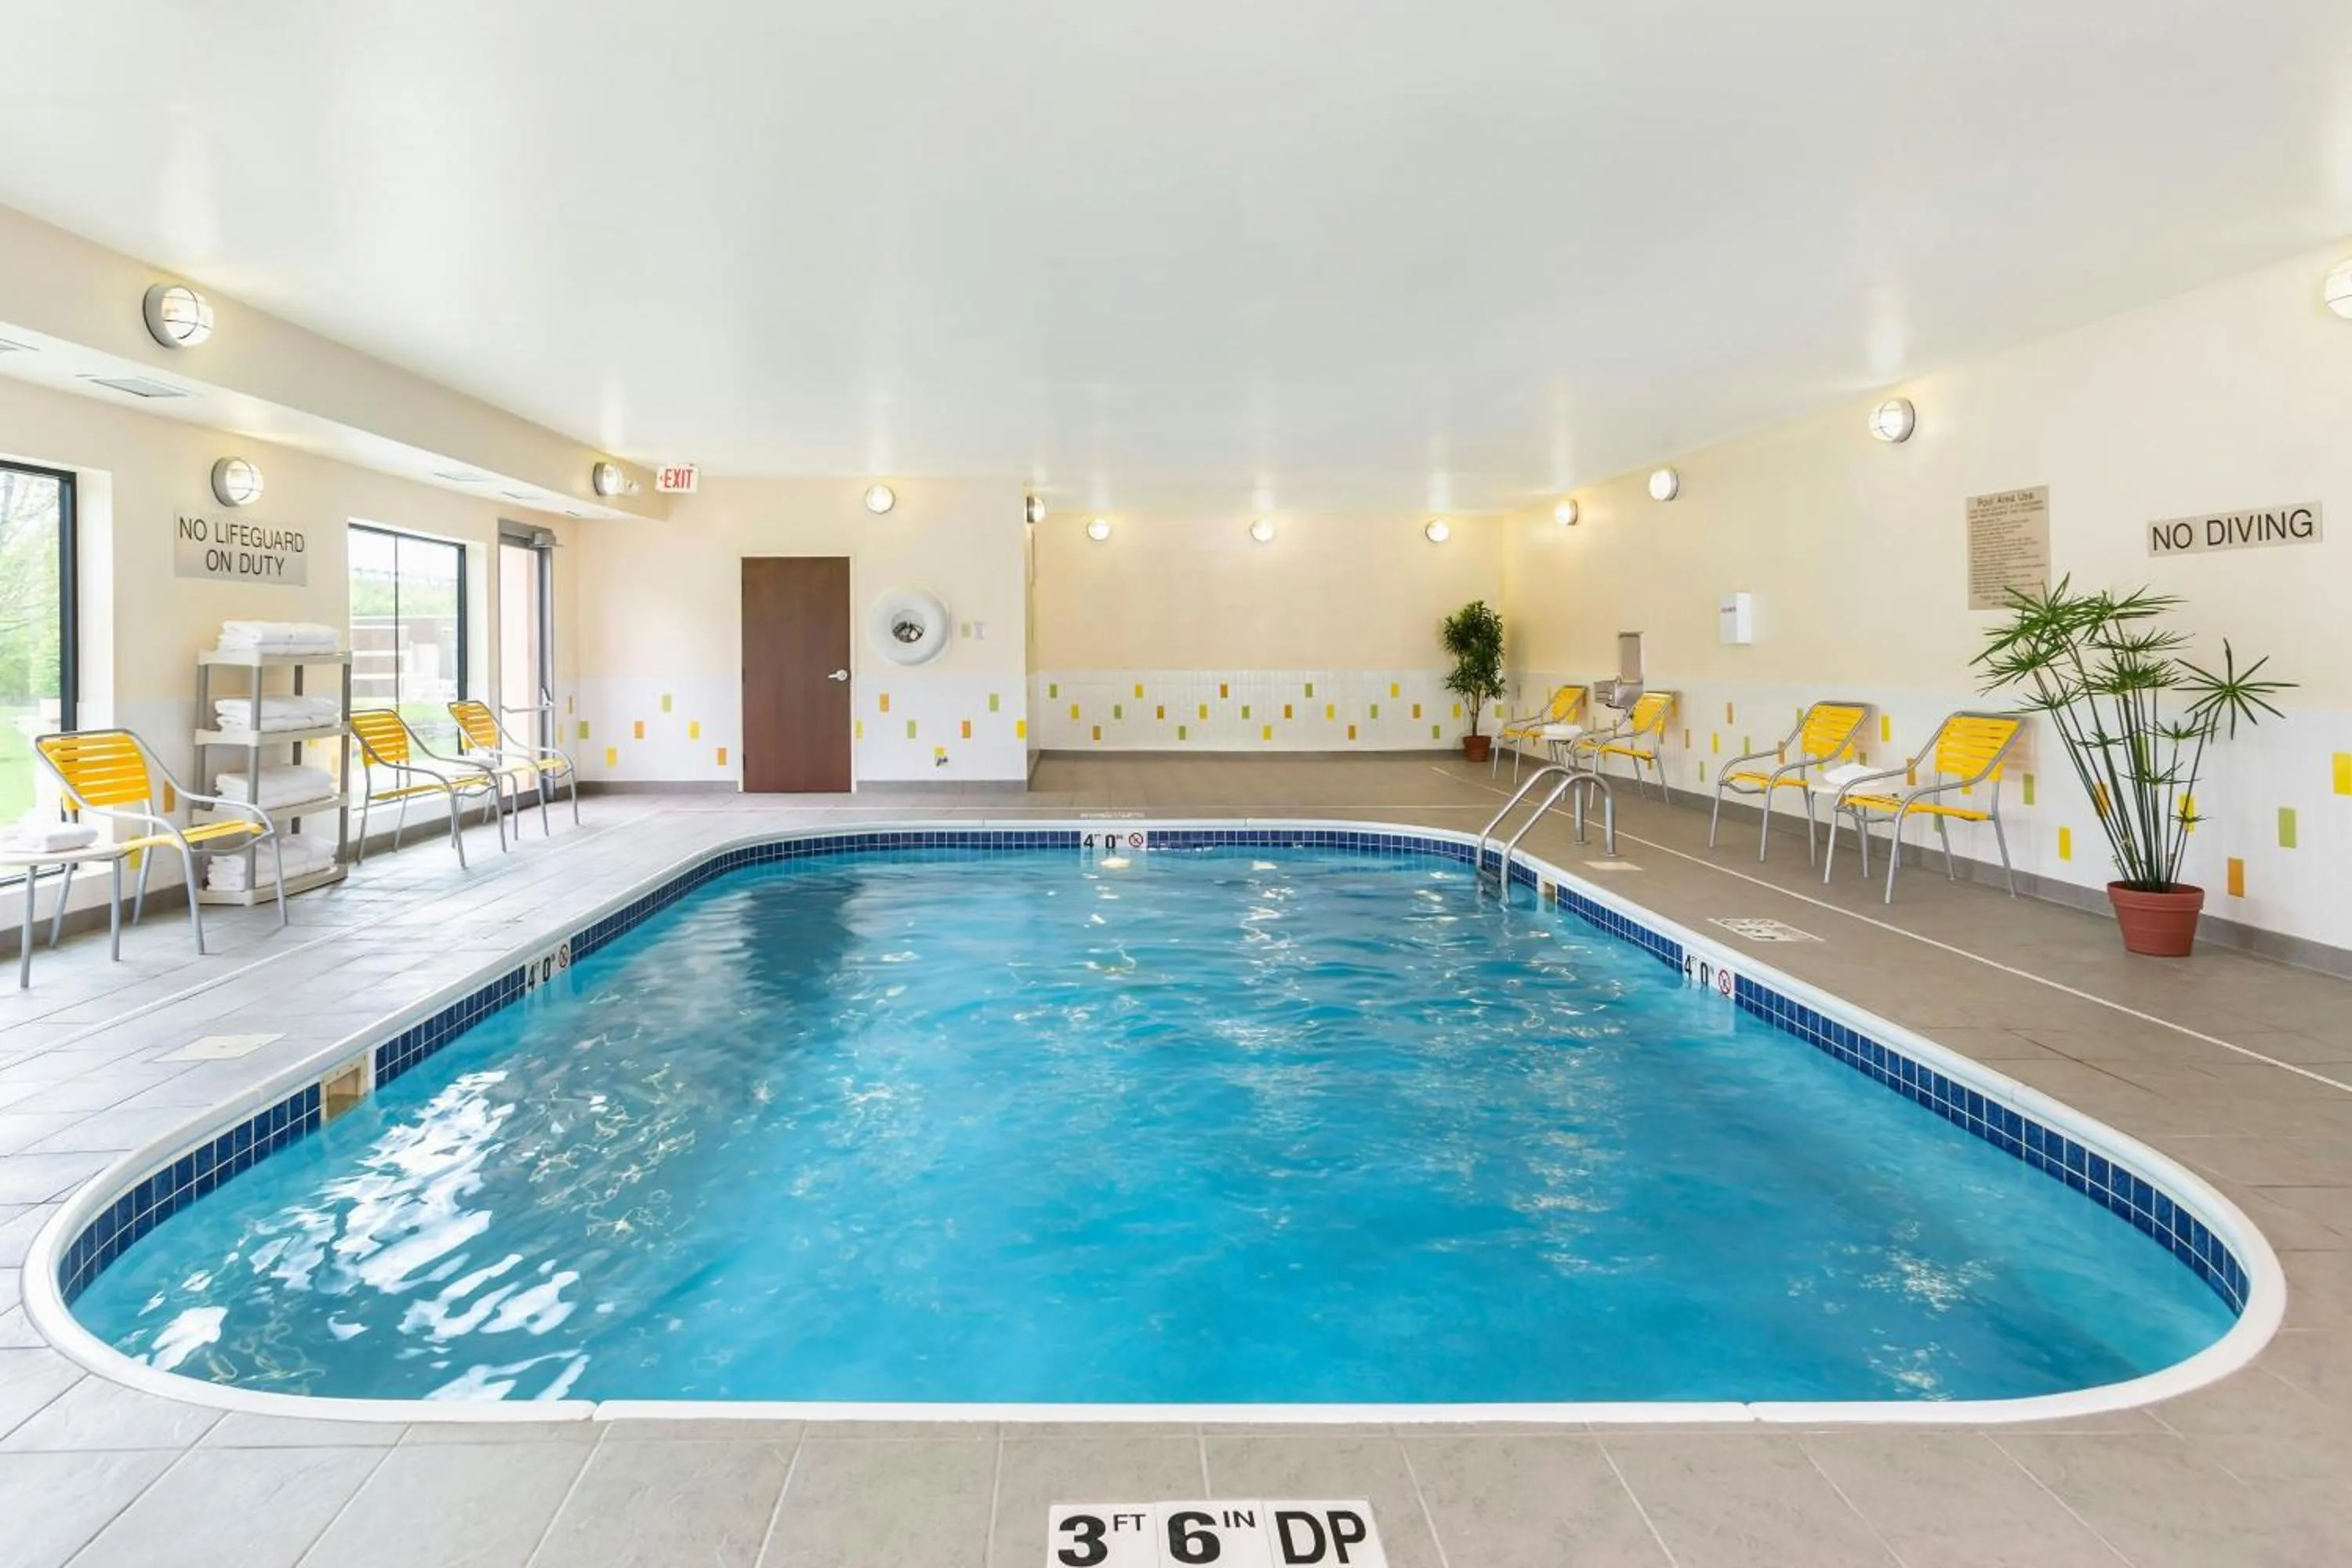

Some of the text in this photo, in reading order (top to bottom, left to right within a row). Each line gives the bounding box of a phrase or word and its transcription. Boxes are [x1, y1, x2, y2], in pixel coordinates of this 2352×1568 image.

[664, 468, 694, 488] EXIT
[179, 517, 305, 553] NO LIFEGUARD
[2152, 509, 2313, 550] NO DIVING
[206, 549, 285, 576] ON DUTY
[1112, 1513, 1146, 1532] FT
[1223, 1510, 1256, 1529] IN
[1275, 1511, 1367, 1565] DP
